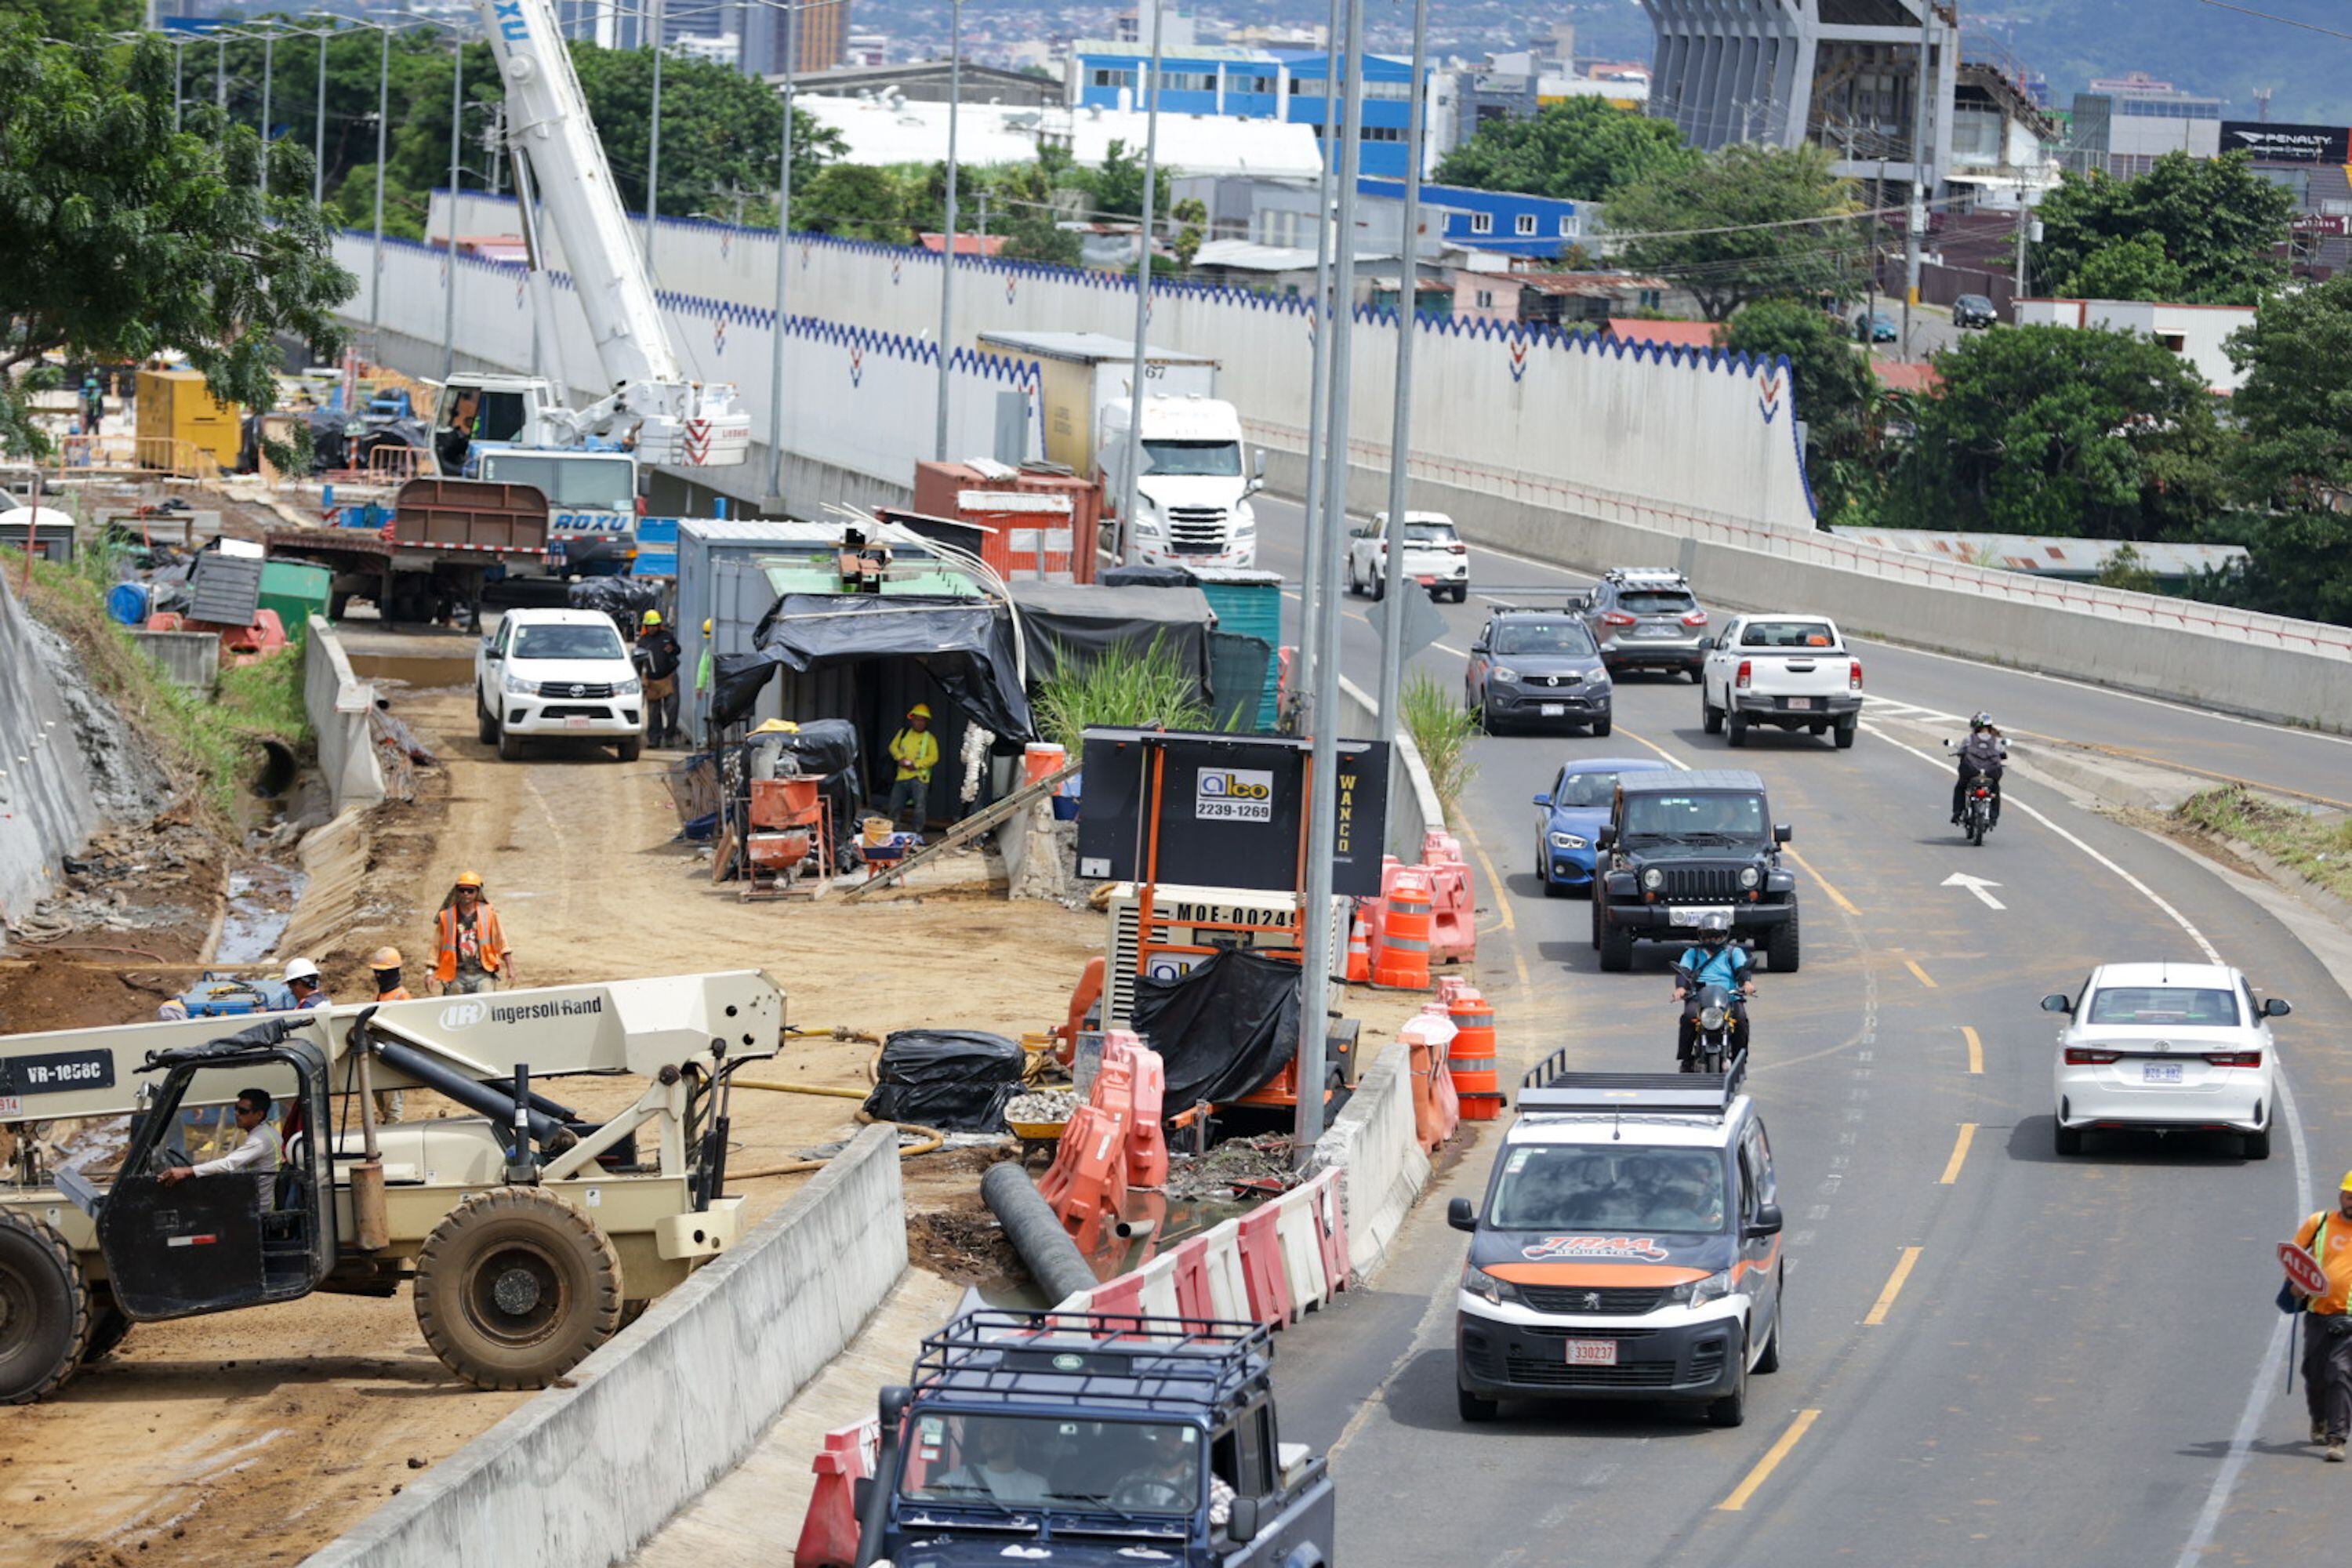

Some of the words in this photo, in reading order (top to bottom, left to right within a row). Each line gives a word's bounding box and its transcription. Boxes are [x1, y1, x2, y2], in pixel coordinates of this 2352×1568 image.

[2266, 133, 2331, 145] PENALTY
[1145, 365, 1165, 379] 67
[554, 514, 628, 531] ROXU
[1203, 773, 1269, 800] alco
[1198, 804, 1269, 818] 2239-1269
[1338, 774, 1357, 852] WANCO
[447, 1004, 478, 1026] IR
[1544, 1236, 1653, 1250] TRAA
[2283, 1250, 2322, 1289] ALTO
